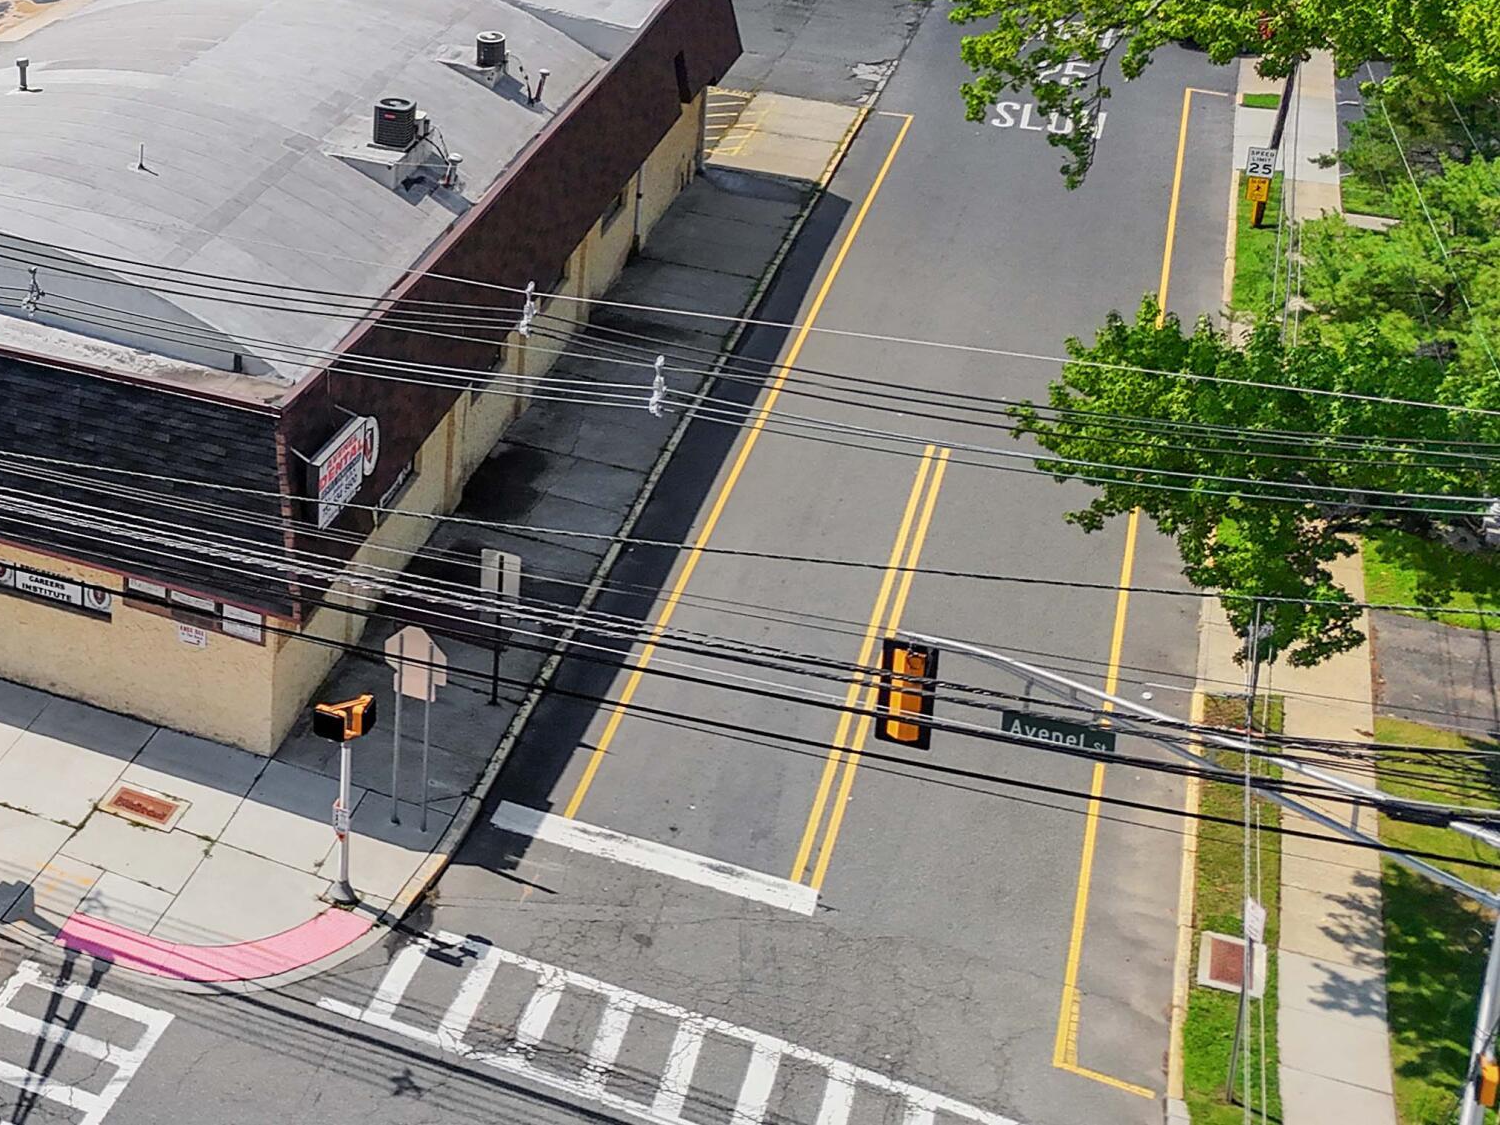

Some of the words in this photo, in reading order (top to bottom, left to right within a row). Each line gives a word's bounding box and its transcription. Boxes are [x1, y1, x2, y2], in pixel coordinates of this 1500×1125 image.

[1249, 162, 1272, 175] 25
[318, 439, 365, 493] DENTAL
[22, 582, 72, 603] INSTITUTE
[28, 575, 66, 590] CAREERS
[1010, 718, 1085, 749] Avenel
